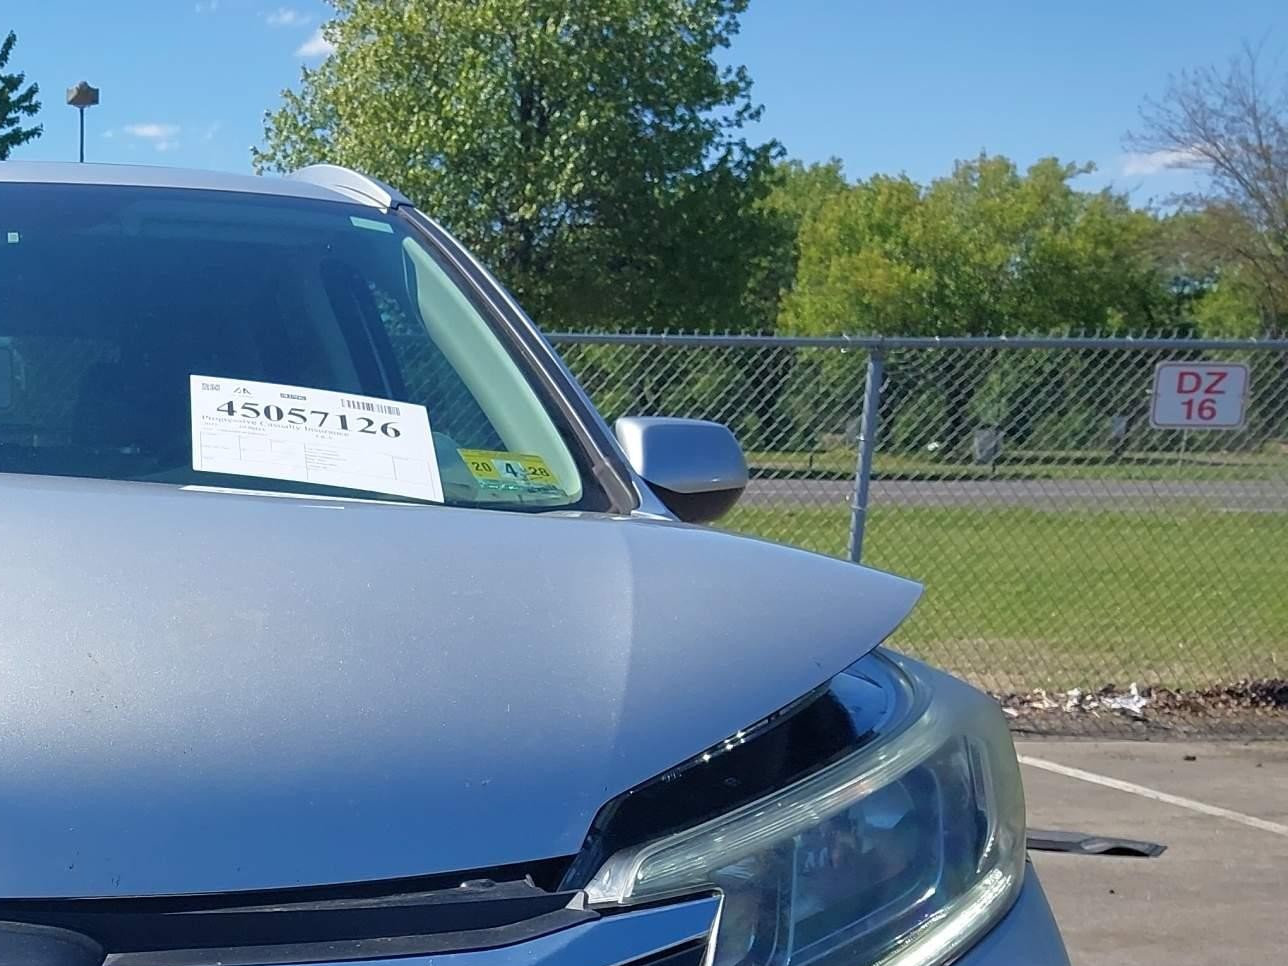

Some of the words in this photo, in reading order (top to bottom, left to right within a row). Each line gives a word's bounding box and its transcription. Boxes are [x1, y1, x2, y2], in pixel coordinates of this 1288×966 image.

[1176, 371, 1228, 394] DZ
[216, 400, 401, 438] 45057126
[1181, 398, 1217, 421] 16
[471, 461, 492, 472] 20
[505, 463, 518, 477] 4
